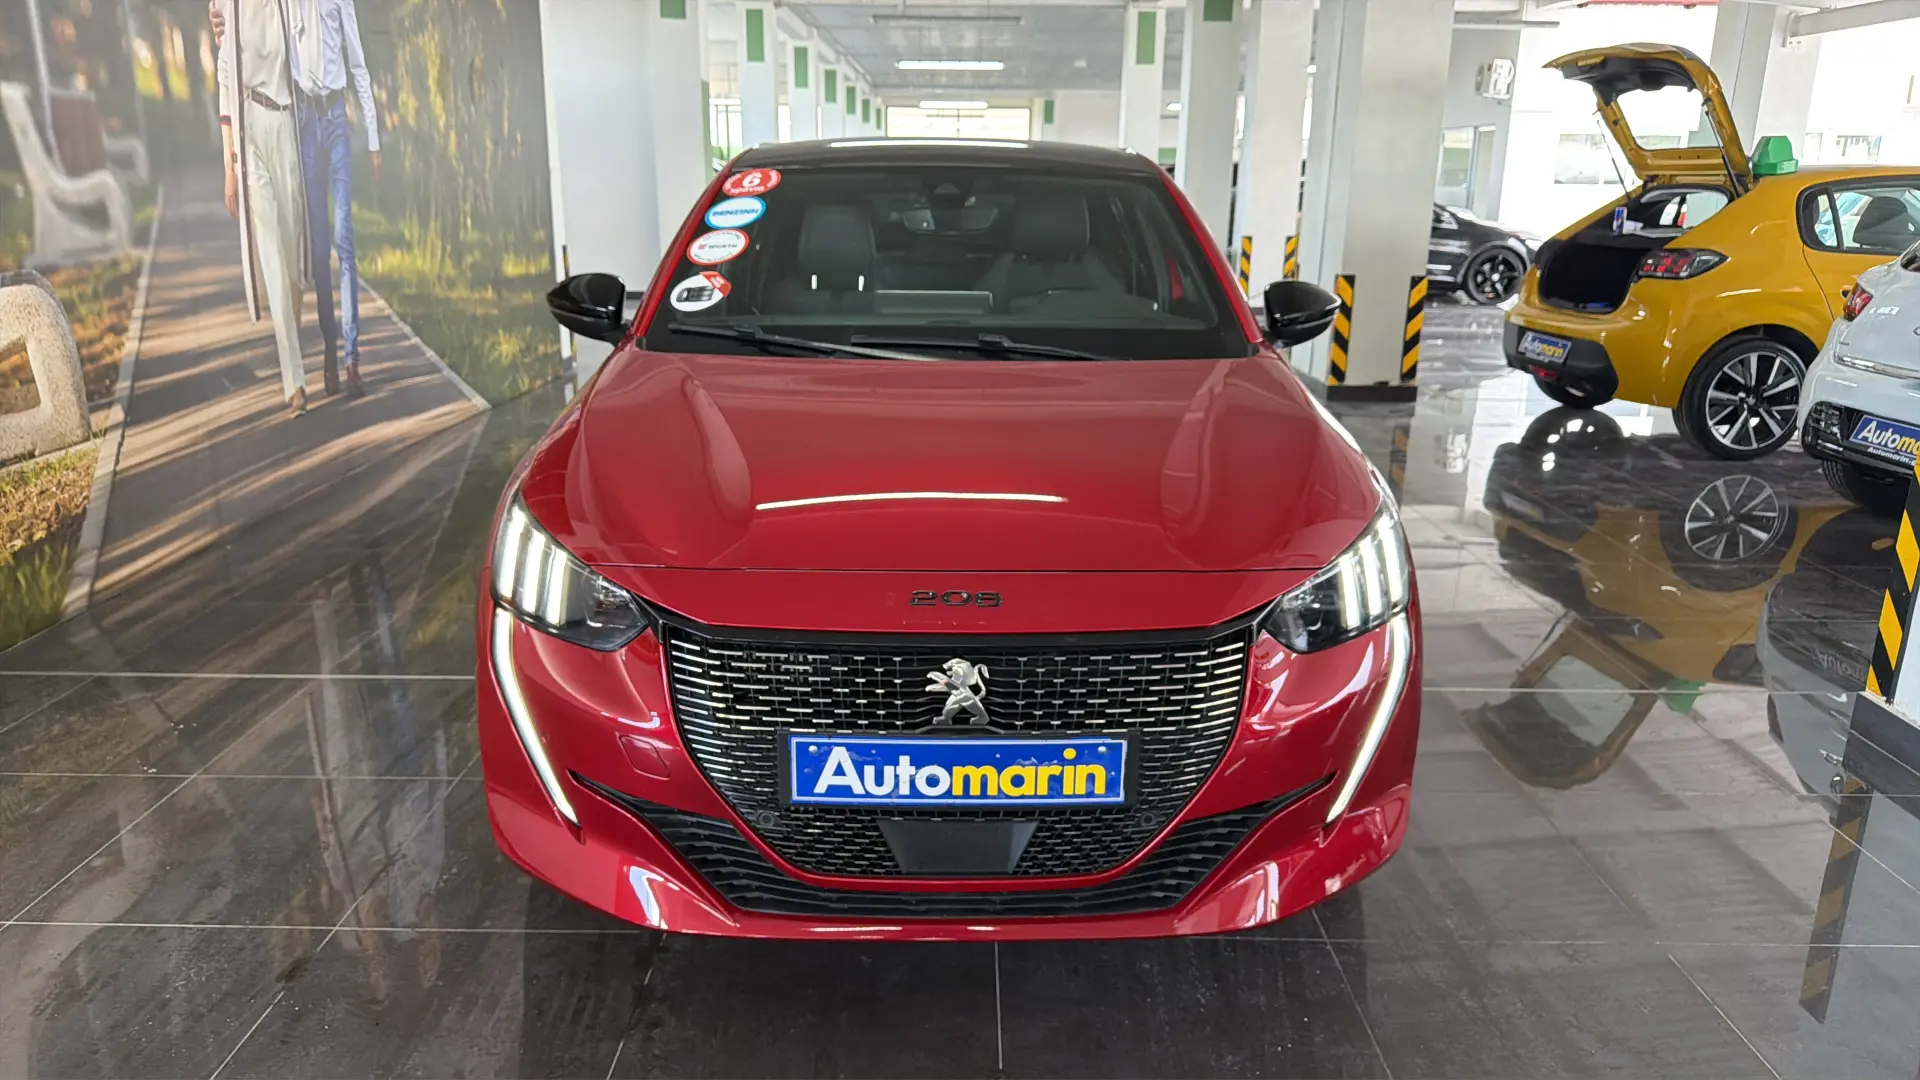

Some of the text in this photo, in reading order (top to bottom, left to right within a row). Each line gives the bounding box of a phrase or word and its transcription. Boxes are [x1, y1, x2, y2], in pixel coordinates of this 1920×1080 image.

[742, 172, 762, 188] 6
[910, 589, 1003, 608] 208
[813, 746, 1107, 796] Automarin
